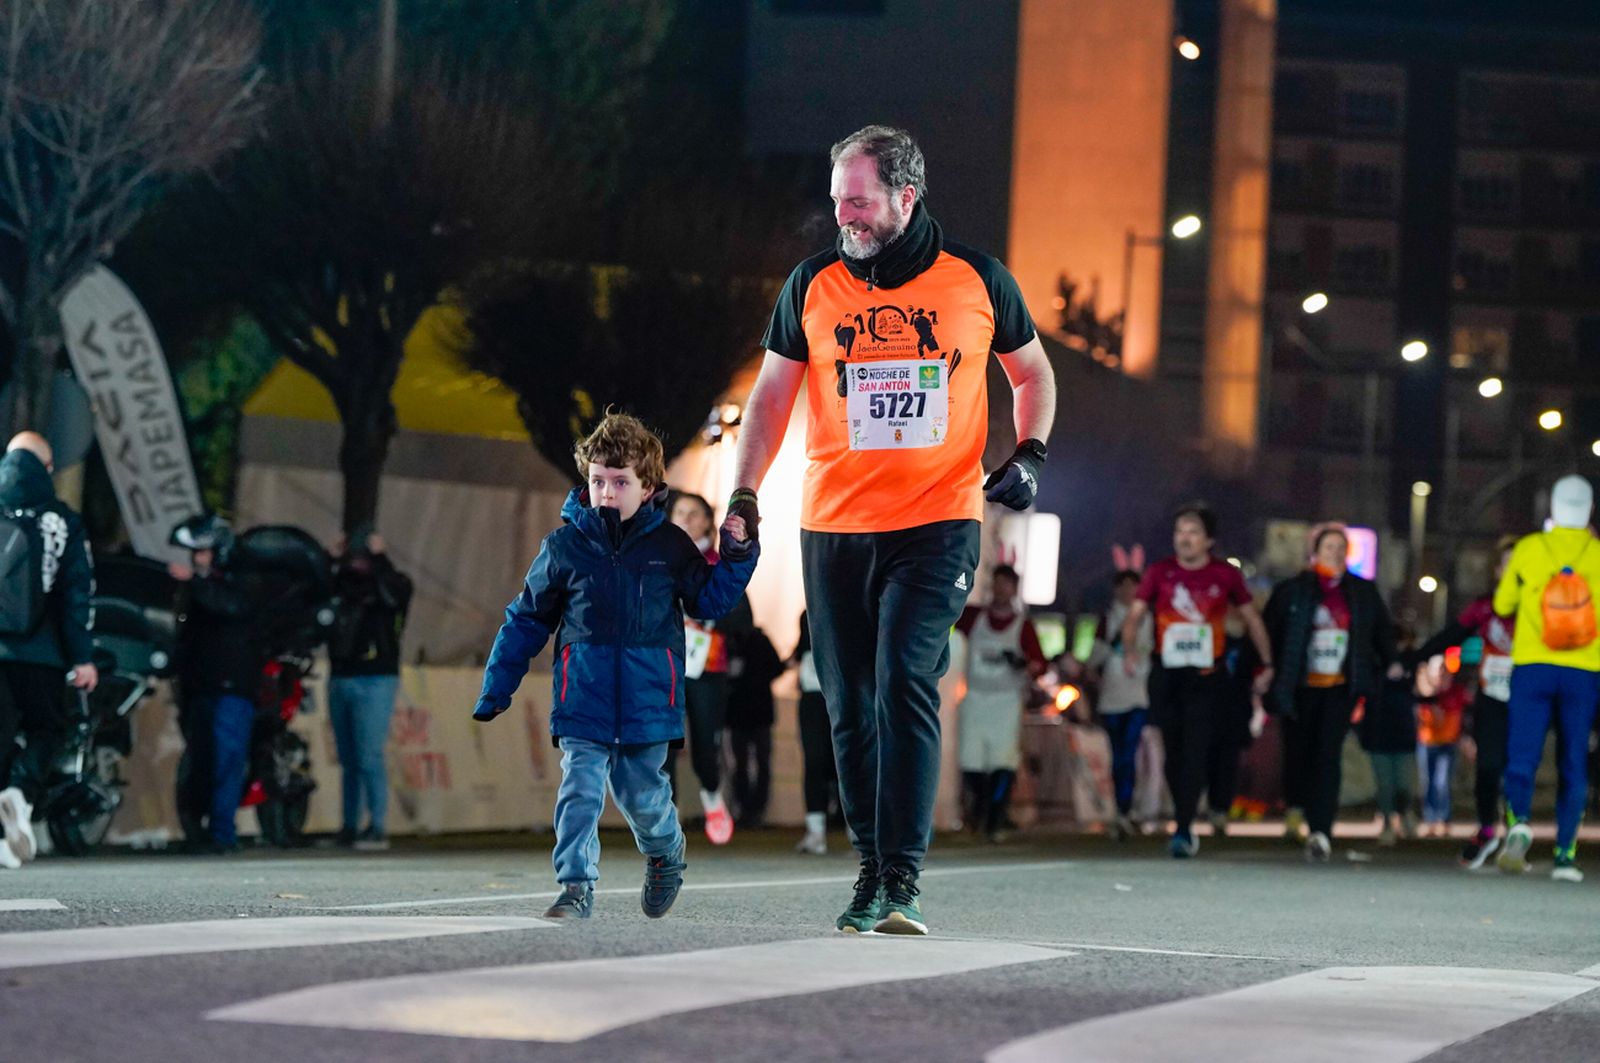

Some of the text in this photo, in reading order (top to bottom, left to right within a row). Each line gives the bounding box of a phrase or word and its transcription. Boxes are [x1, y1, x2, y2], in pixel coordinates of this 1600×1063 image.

[869, 370, 910, 380] NOCHE DE
[858, 382, 877, 392] SAN
[879, 379, 911, 391] ANTÓN
[109, 310, 190, 513] JAPEMASA
[869, 392, 926, 419] 5727
[888, 419, 908, 427] Rafael
